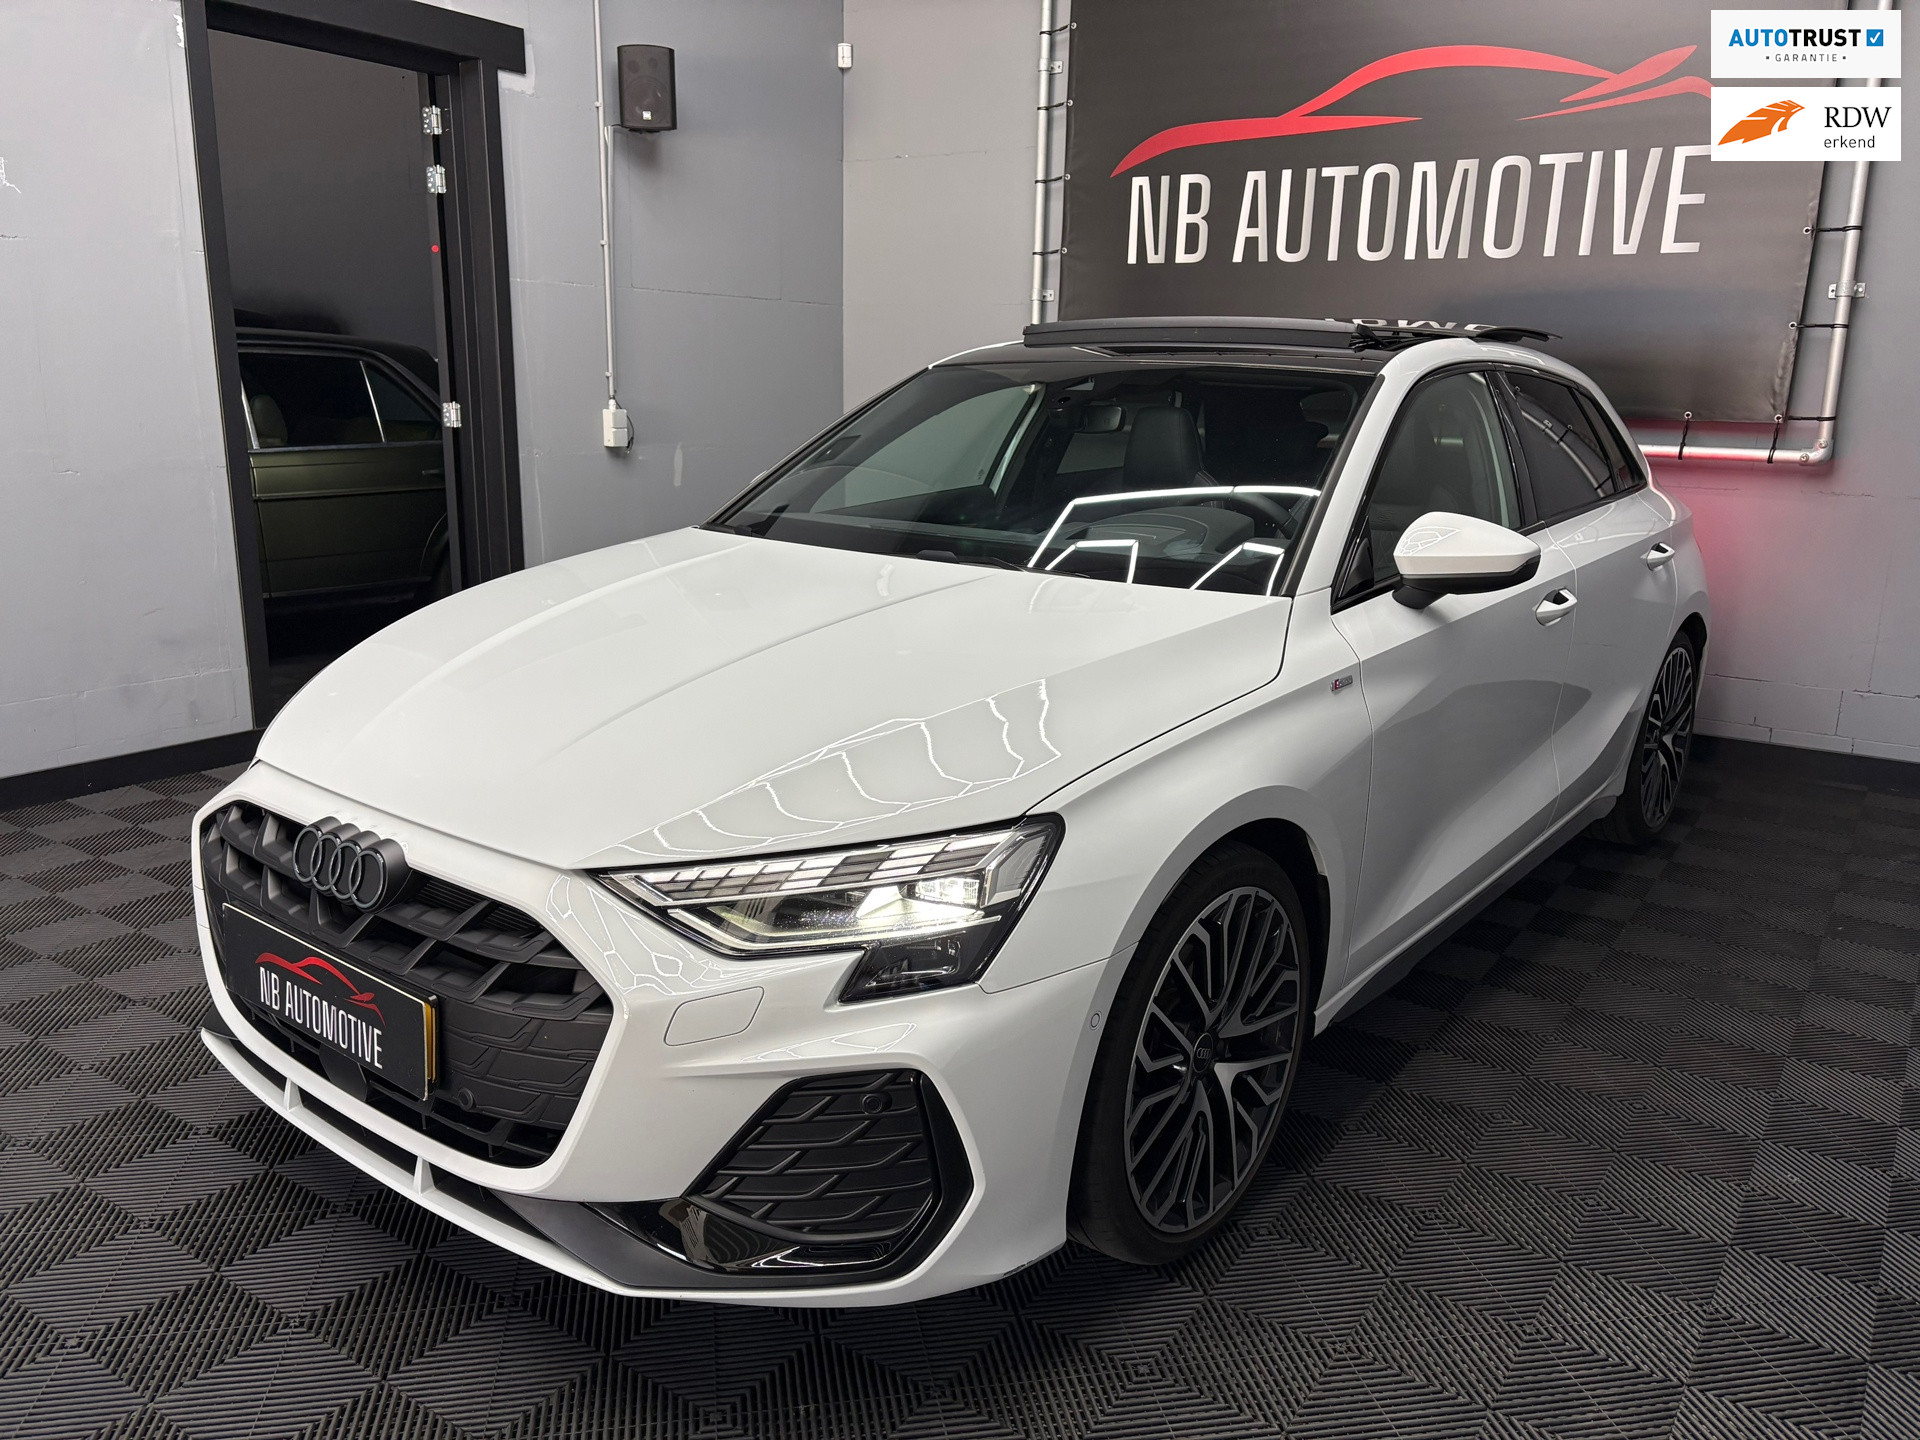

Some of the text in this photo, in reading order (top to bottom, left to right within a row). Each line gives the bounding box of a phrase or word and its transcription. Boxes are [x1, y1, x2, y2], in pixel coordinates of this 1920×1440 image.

[1127, 144, 1710, 264] NB AUTOMOTIVE
[259, 966, 383, 1069] NB AUTOMOTIVE
